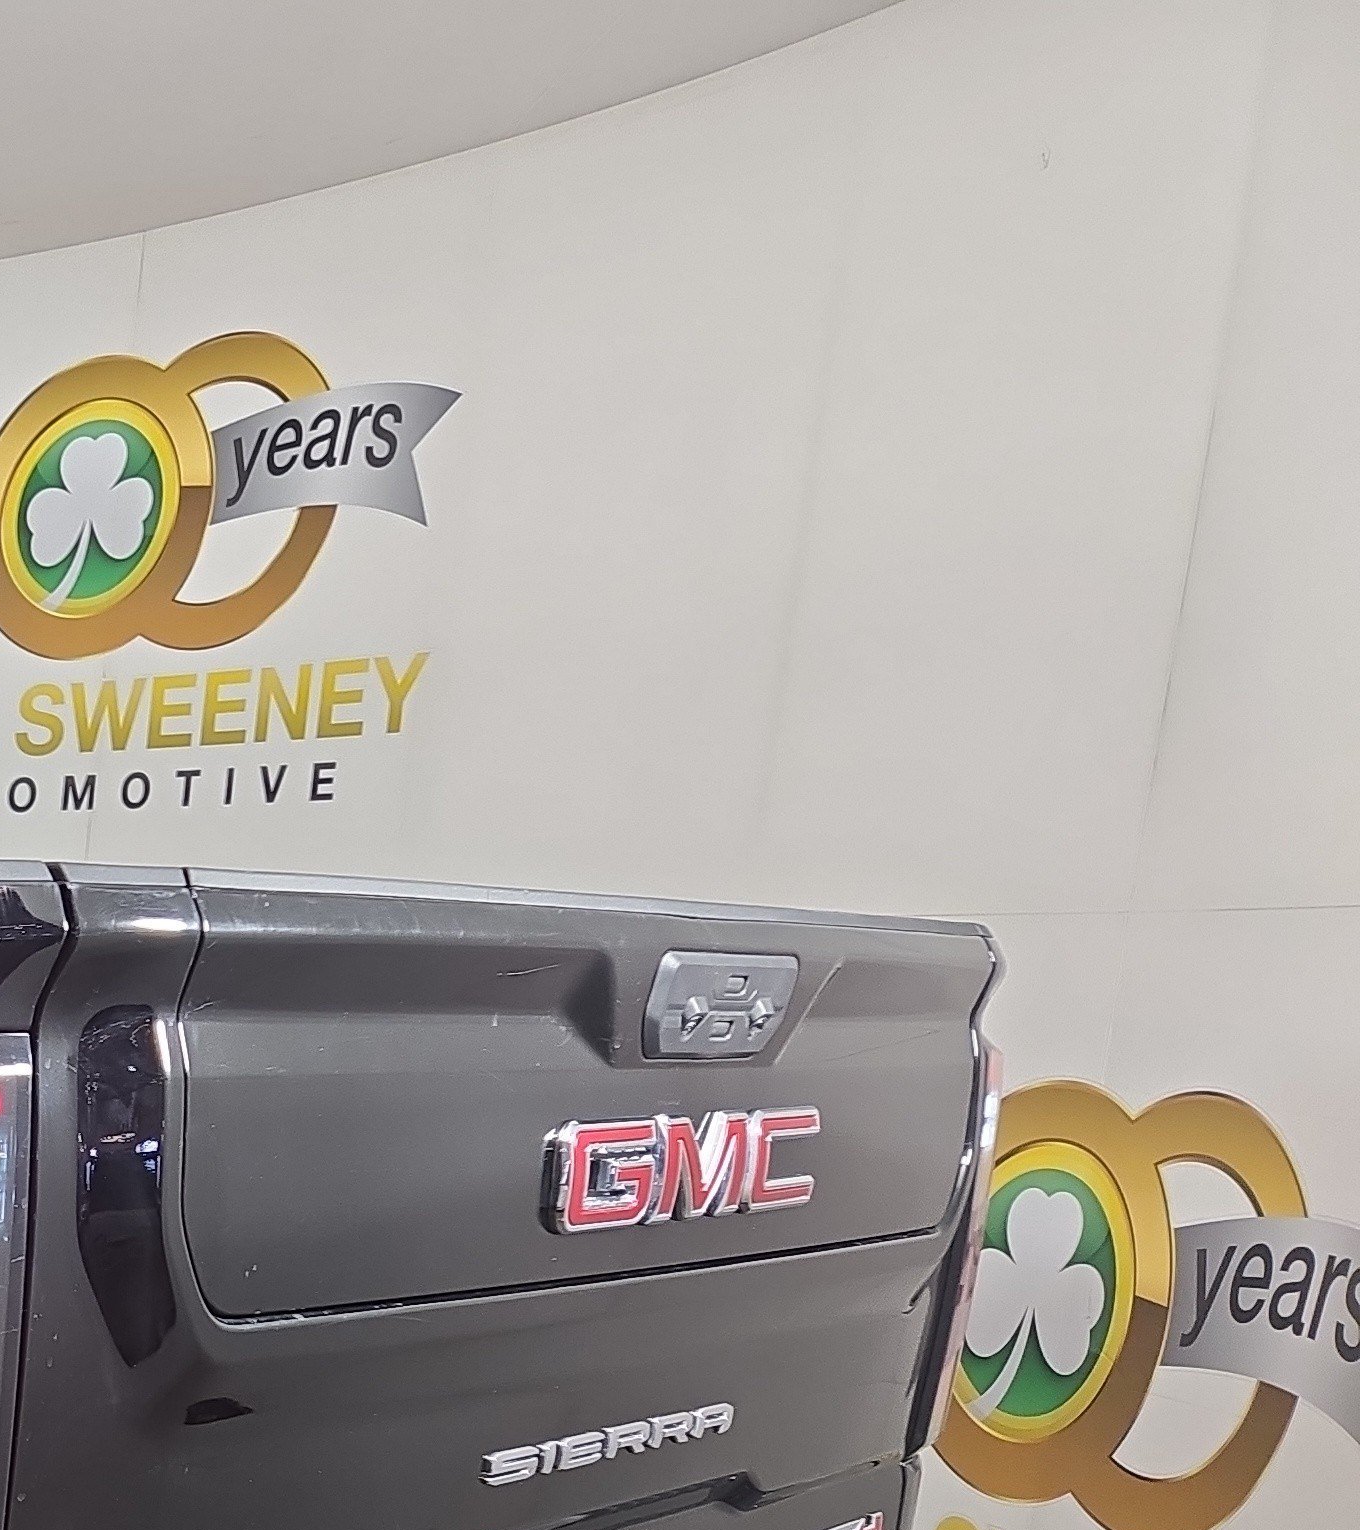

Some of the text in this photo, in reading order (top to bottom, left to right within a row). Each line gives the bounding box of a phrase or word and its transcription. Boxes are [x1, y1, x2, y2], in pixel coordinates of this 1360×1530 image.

[226, 402, 403, 506] years
[14, 652, 428, 757] SWEENEY
[540, 1105, 821, 1235] GMC
[1180, 1243, 1360, 1362] years
[479, 1402, 736, 1486] SIERRA
